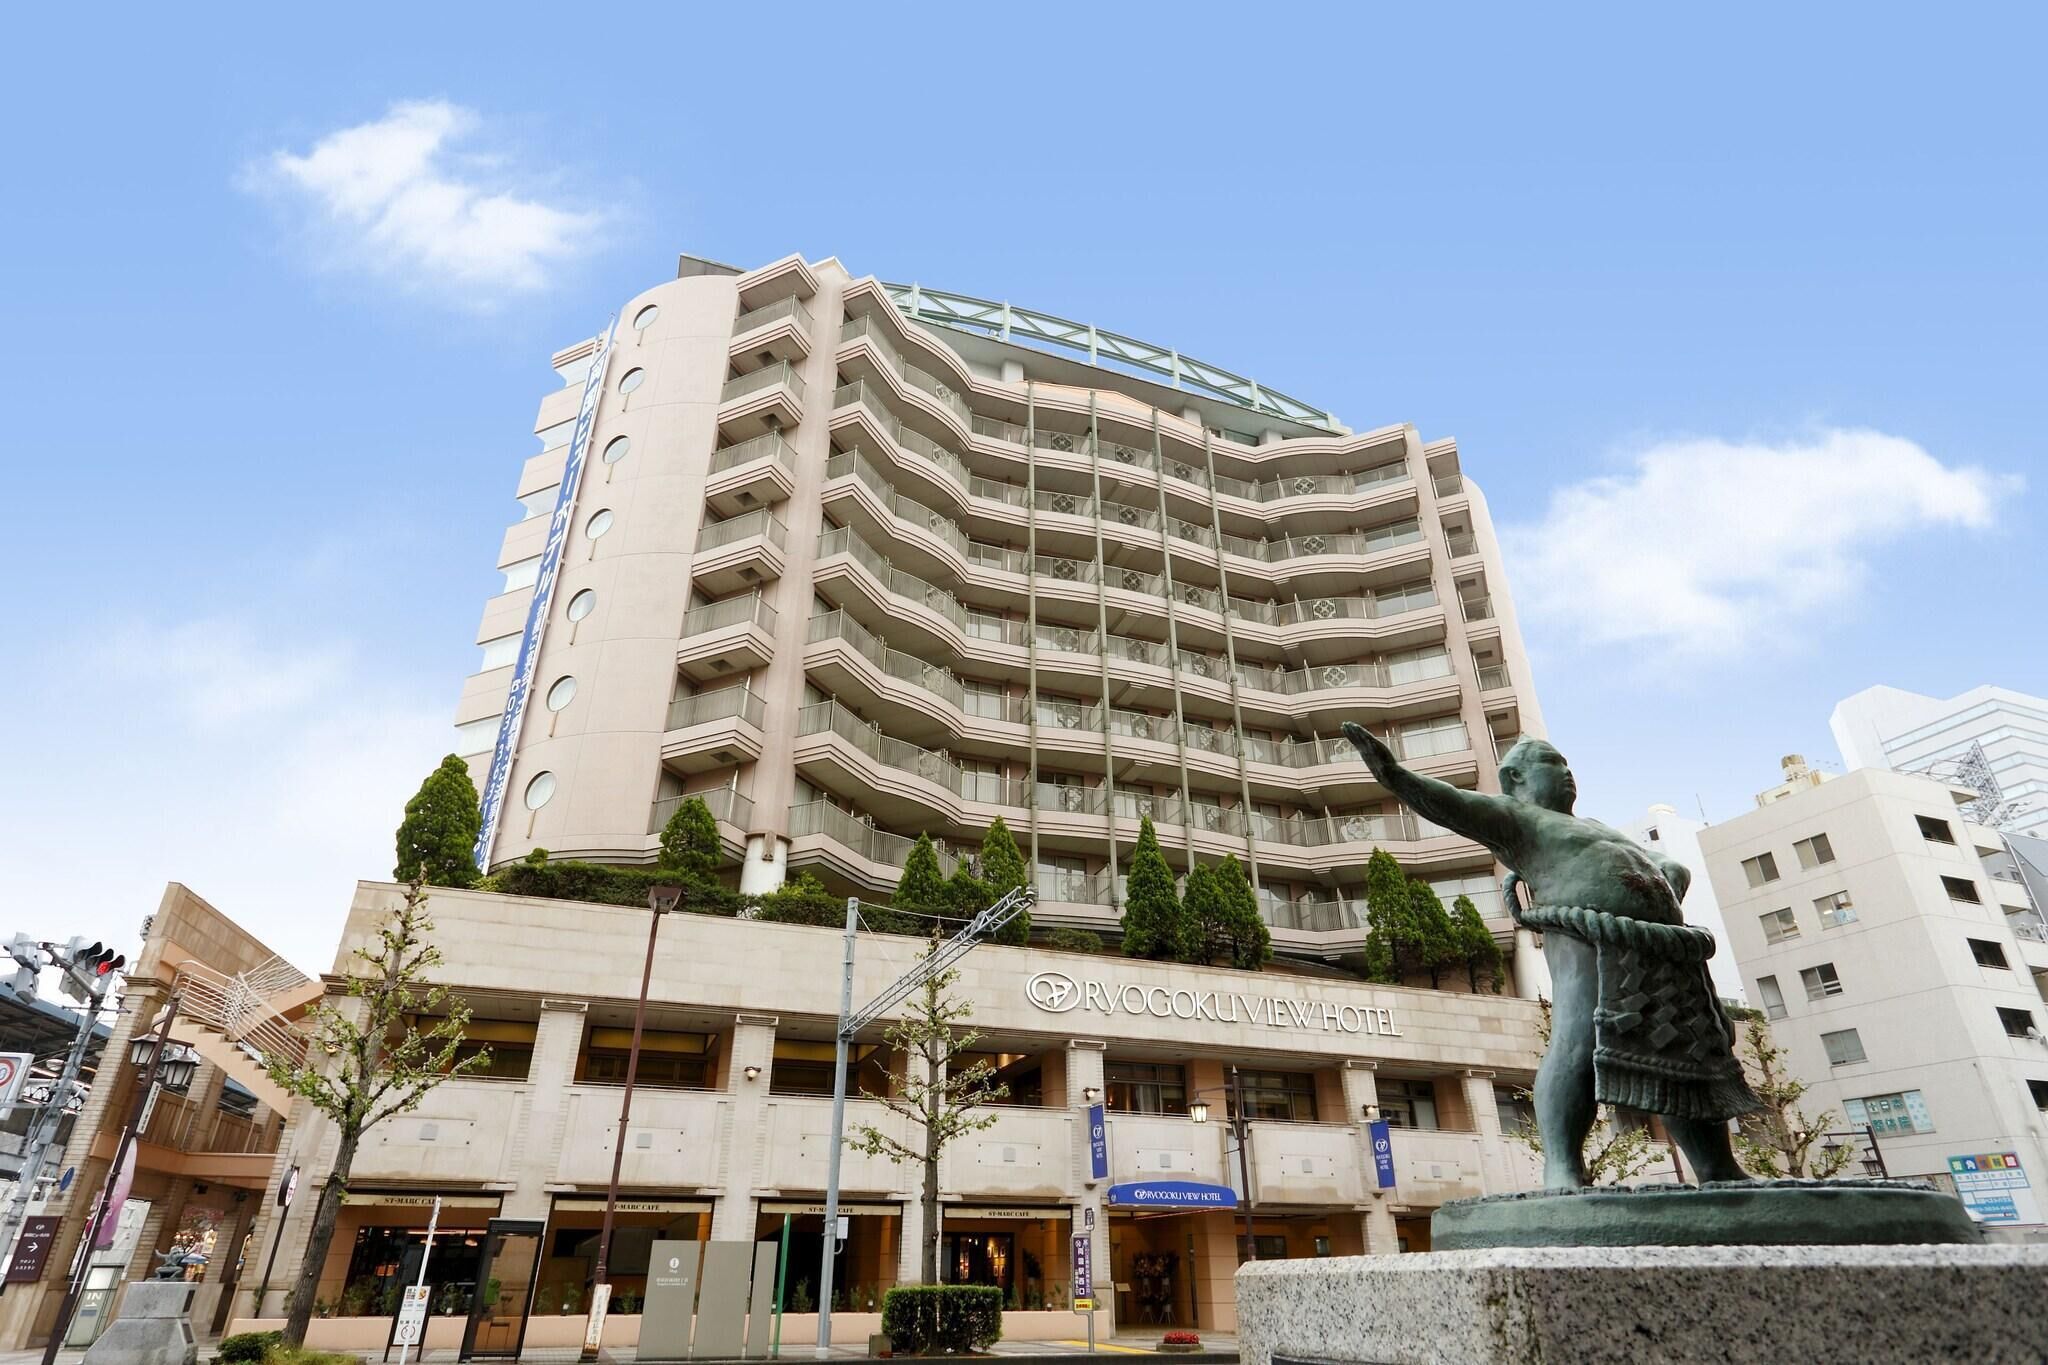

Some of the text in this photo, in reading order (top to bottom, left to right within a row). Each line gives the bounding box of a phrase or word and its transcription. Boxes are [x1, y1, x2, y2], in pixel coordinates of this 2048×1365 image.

[1084, 981, 1404, 1037] RYOGOKU VIEW HOTEL
[1147, 1190, 1221, 1201] RYOGOKU VIEW HOTEL
